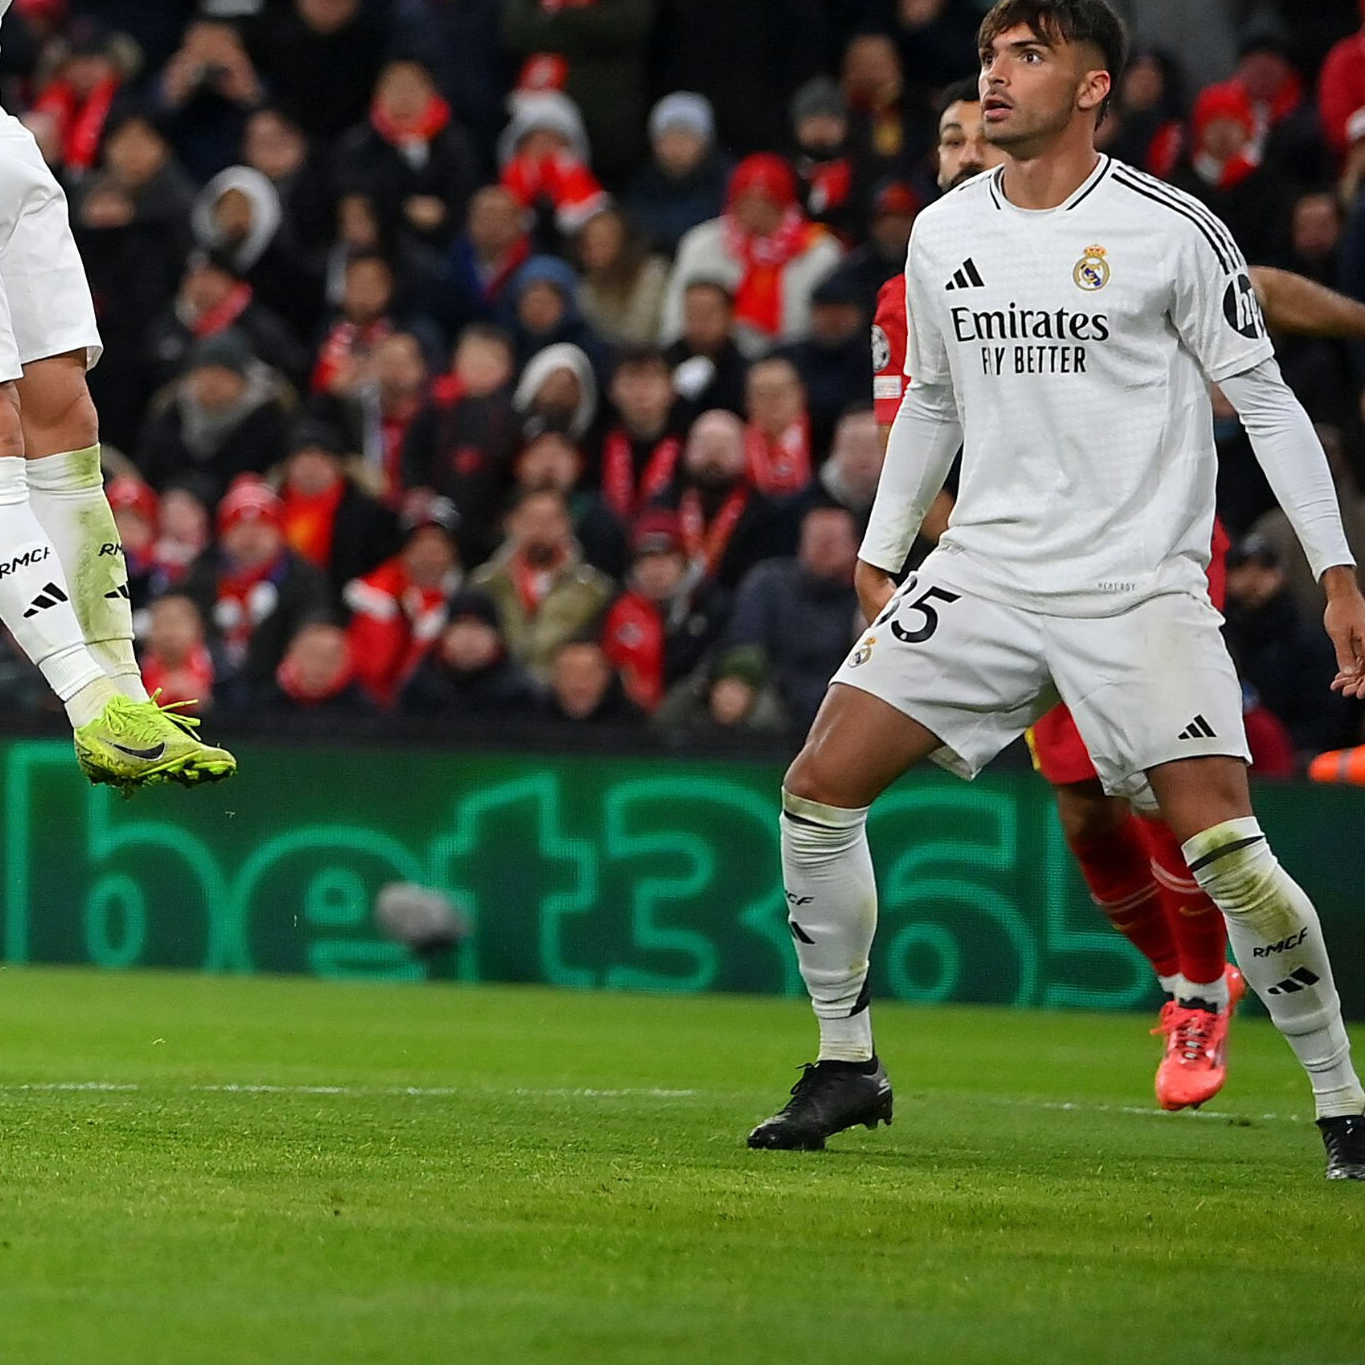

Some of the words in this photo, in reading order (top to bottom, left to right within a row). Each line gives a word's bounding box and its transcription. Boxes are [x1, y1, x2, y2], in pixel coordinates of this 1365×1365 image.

[951, 302, 1109, 343] Emirates
[981, 346, 1006, 376] FY
[1014, 346, 1087, 374] BETTER
[1253, 926, 1308, 958] RMCF
